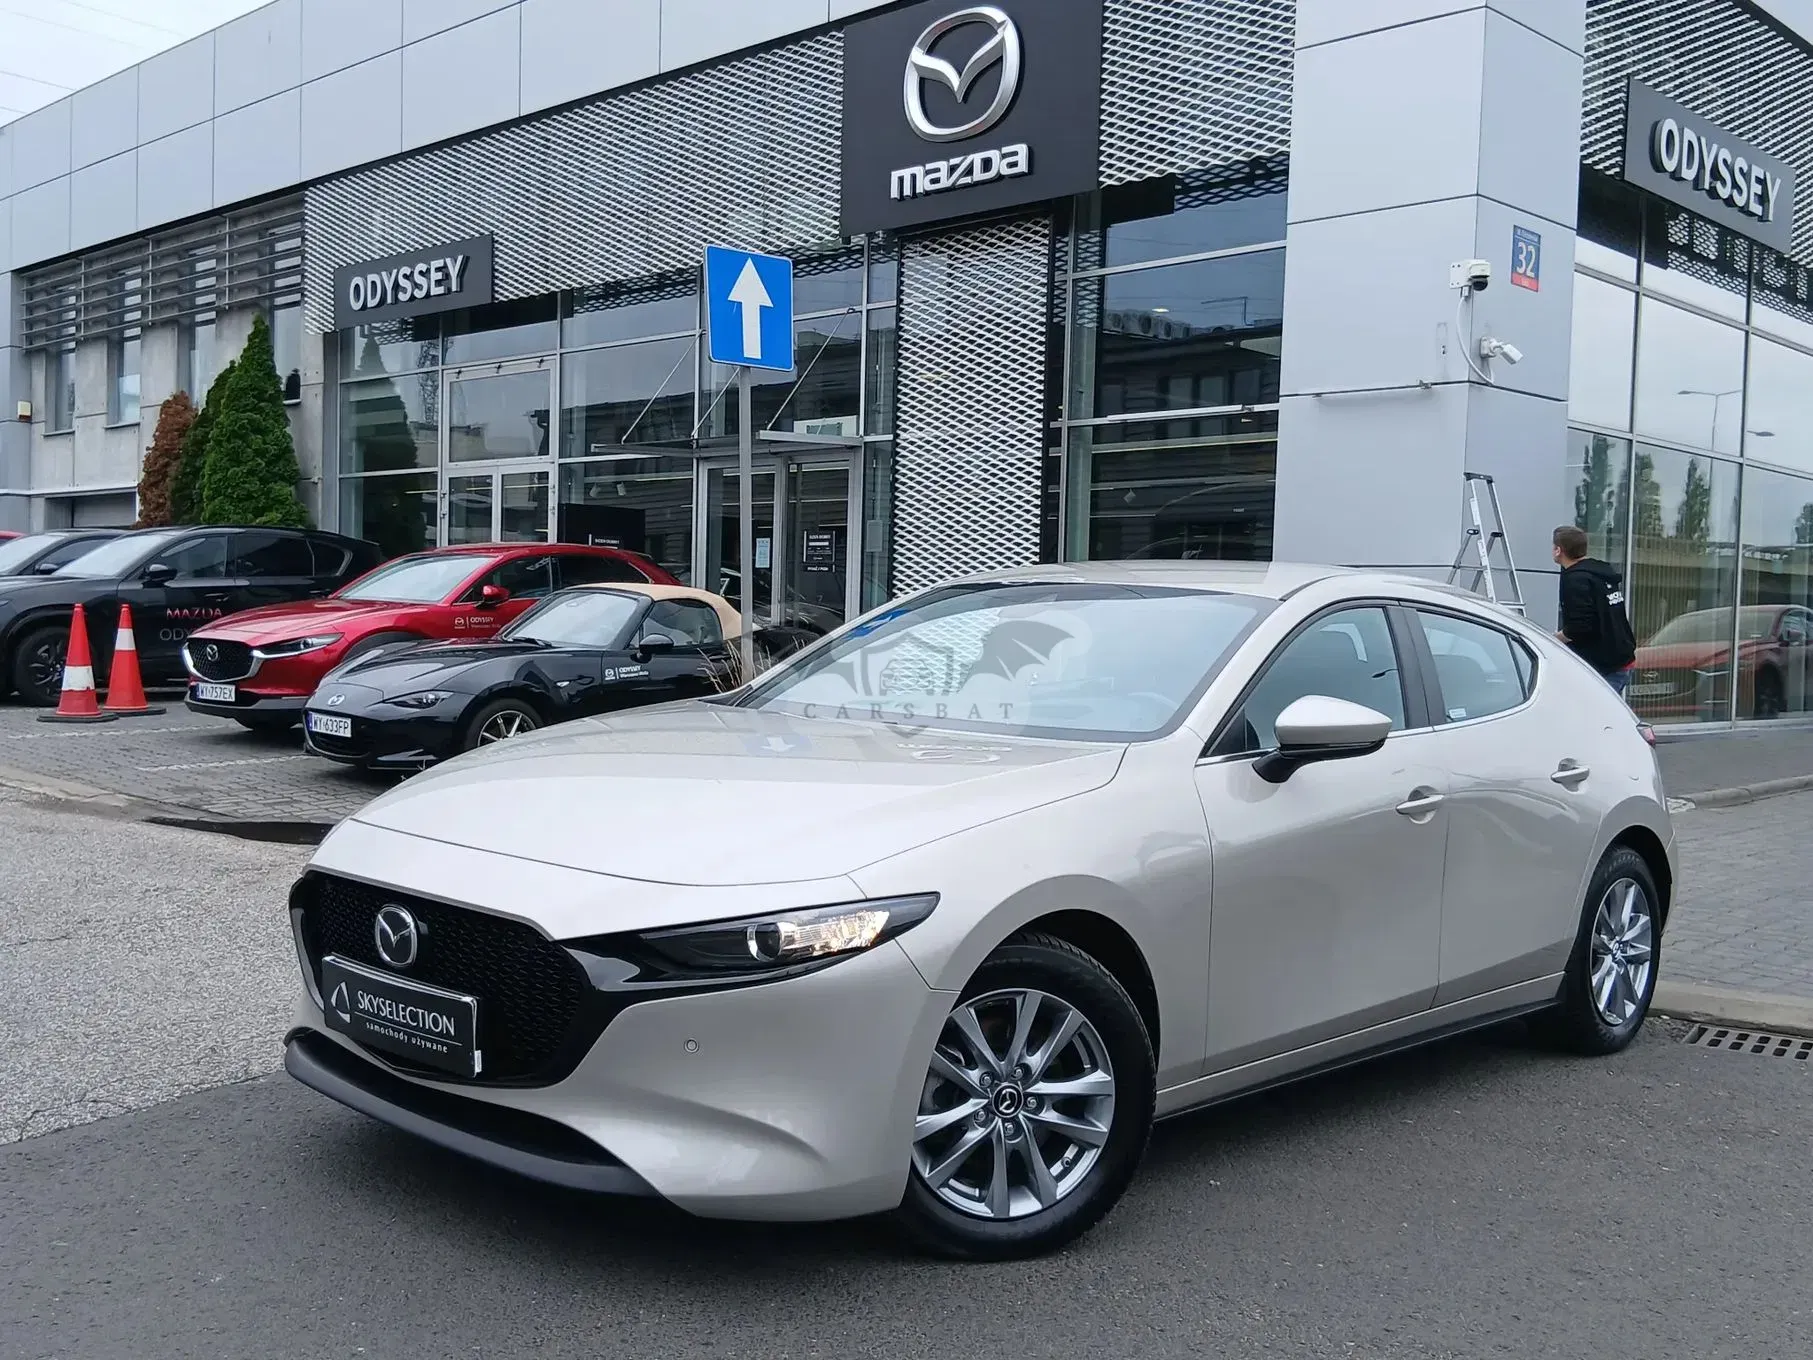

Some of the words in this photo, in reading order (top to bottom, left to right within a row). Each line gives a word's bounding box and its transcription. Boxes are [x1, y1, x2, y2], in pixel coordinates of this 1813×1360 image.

[1658, 118, 1781, 222] ODYSSEY
[1516, 241, 1536, 278] 32
[350, 254, 465, 311] ODYSSEY
[166, 607, 222, 619] MAZDA
[325, 718, 349, 734] 633FP
[357, 990, 455, 1036] SKYSELECTION
[366, 1022, 408, 1043] samochody
[411, 1036, 448, 1053] używane
